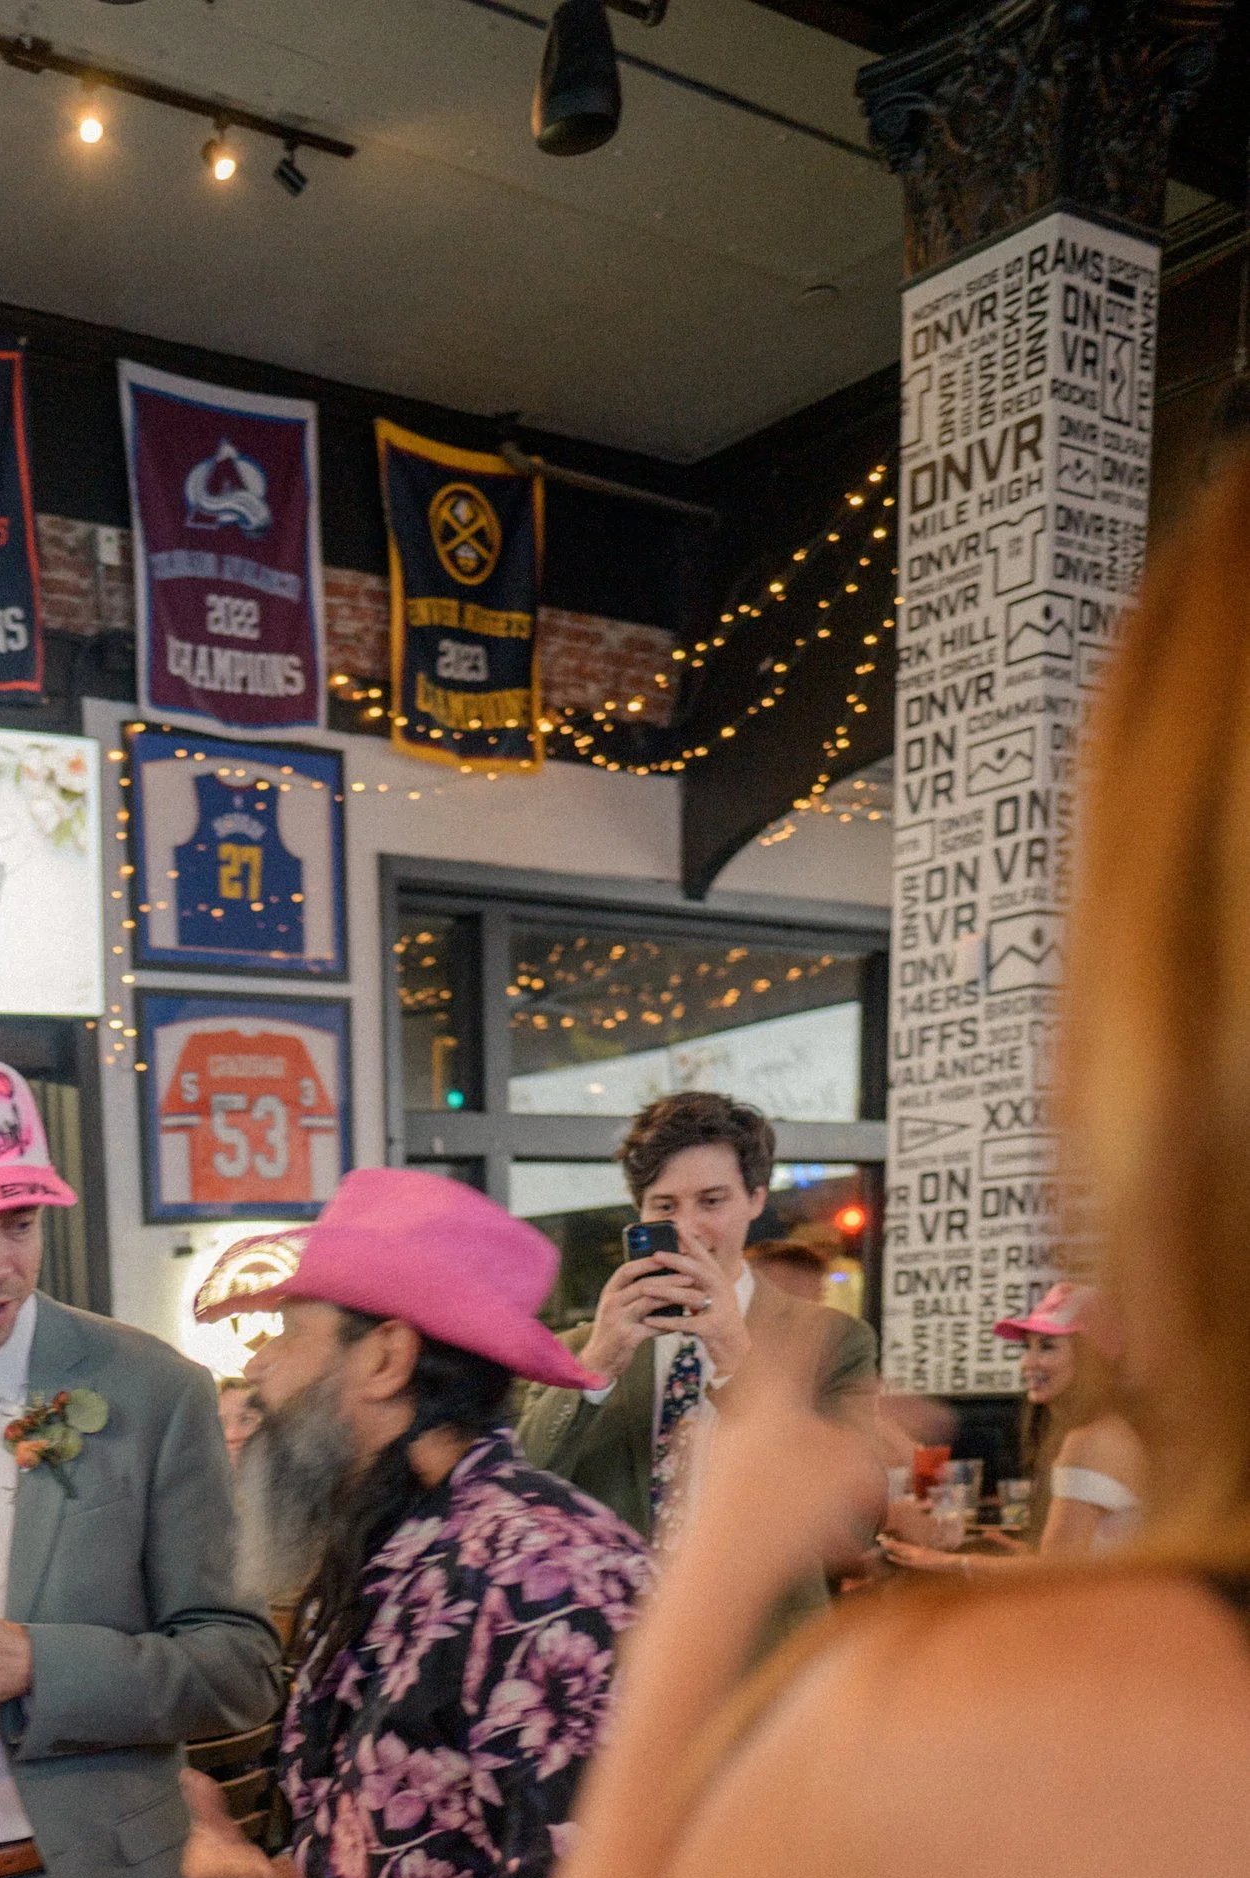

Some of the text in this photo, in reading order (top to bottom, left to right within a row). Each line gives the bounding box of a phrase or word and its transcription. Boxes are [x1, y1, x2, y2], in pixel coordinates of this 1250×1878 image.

[911, 291, 998, 362] DNVR
[1062, 283, 1100, 334] DN
[908, 411, 1044, 515] DNVR
[908, 499, 969, 547] MILE
[979, 466, 1044, 517] HIGH
[908, 531, 982, 583] DNVR
[908, 583, 979, 632] DNVR
[940, 615, 998, 658] HILL
[906, 671, 995, 729] DNVR
[905, 725, 956, 775] DN
[905, 770, 955, 816] VR
[995, 789, 1052, 838] DN
[217, 842, 264, 900] 27
[926, 856, 979, 904] DN
[993, 838, 1049, 884] VR
[925, 902, 977, 946] VR
[900, 952, 956, 989] DNV
[894, 1016, 978, 1059] UFFS
[210, 1091, 290, 1180] 53
[919, 1168, 972, 1205] DN
[918, 1208, 969, 1243] VR
[895, 1264, 972, 1295] DNVR
[913, 1298, 972, 1318] BALL
